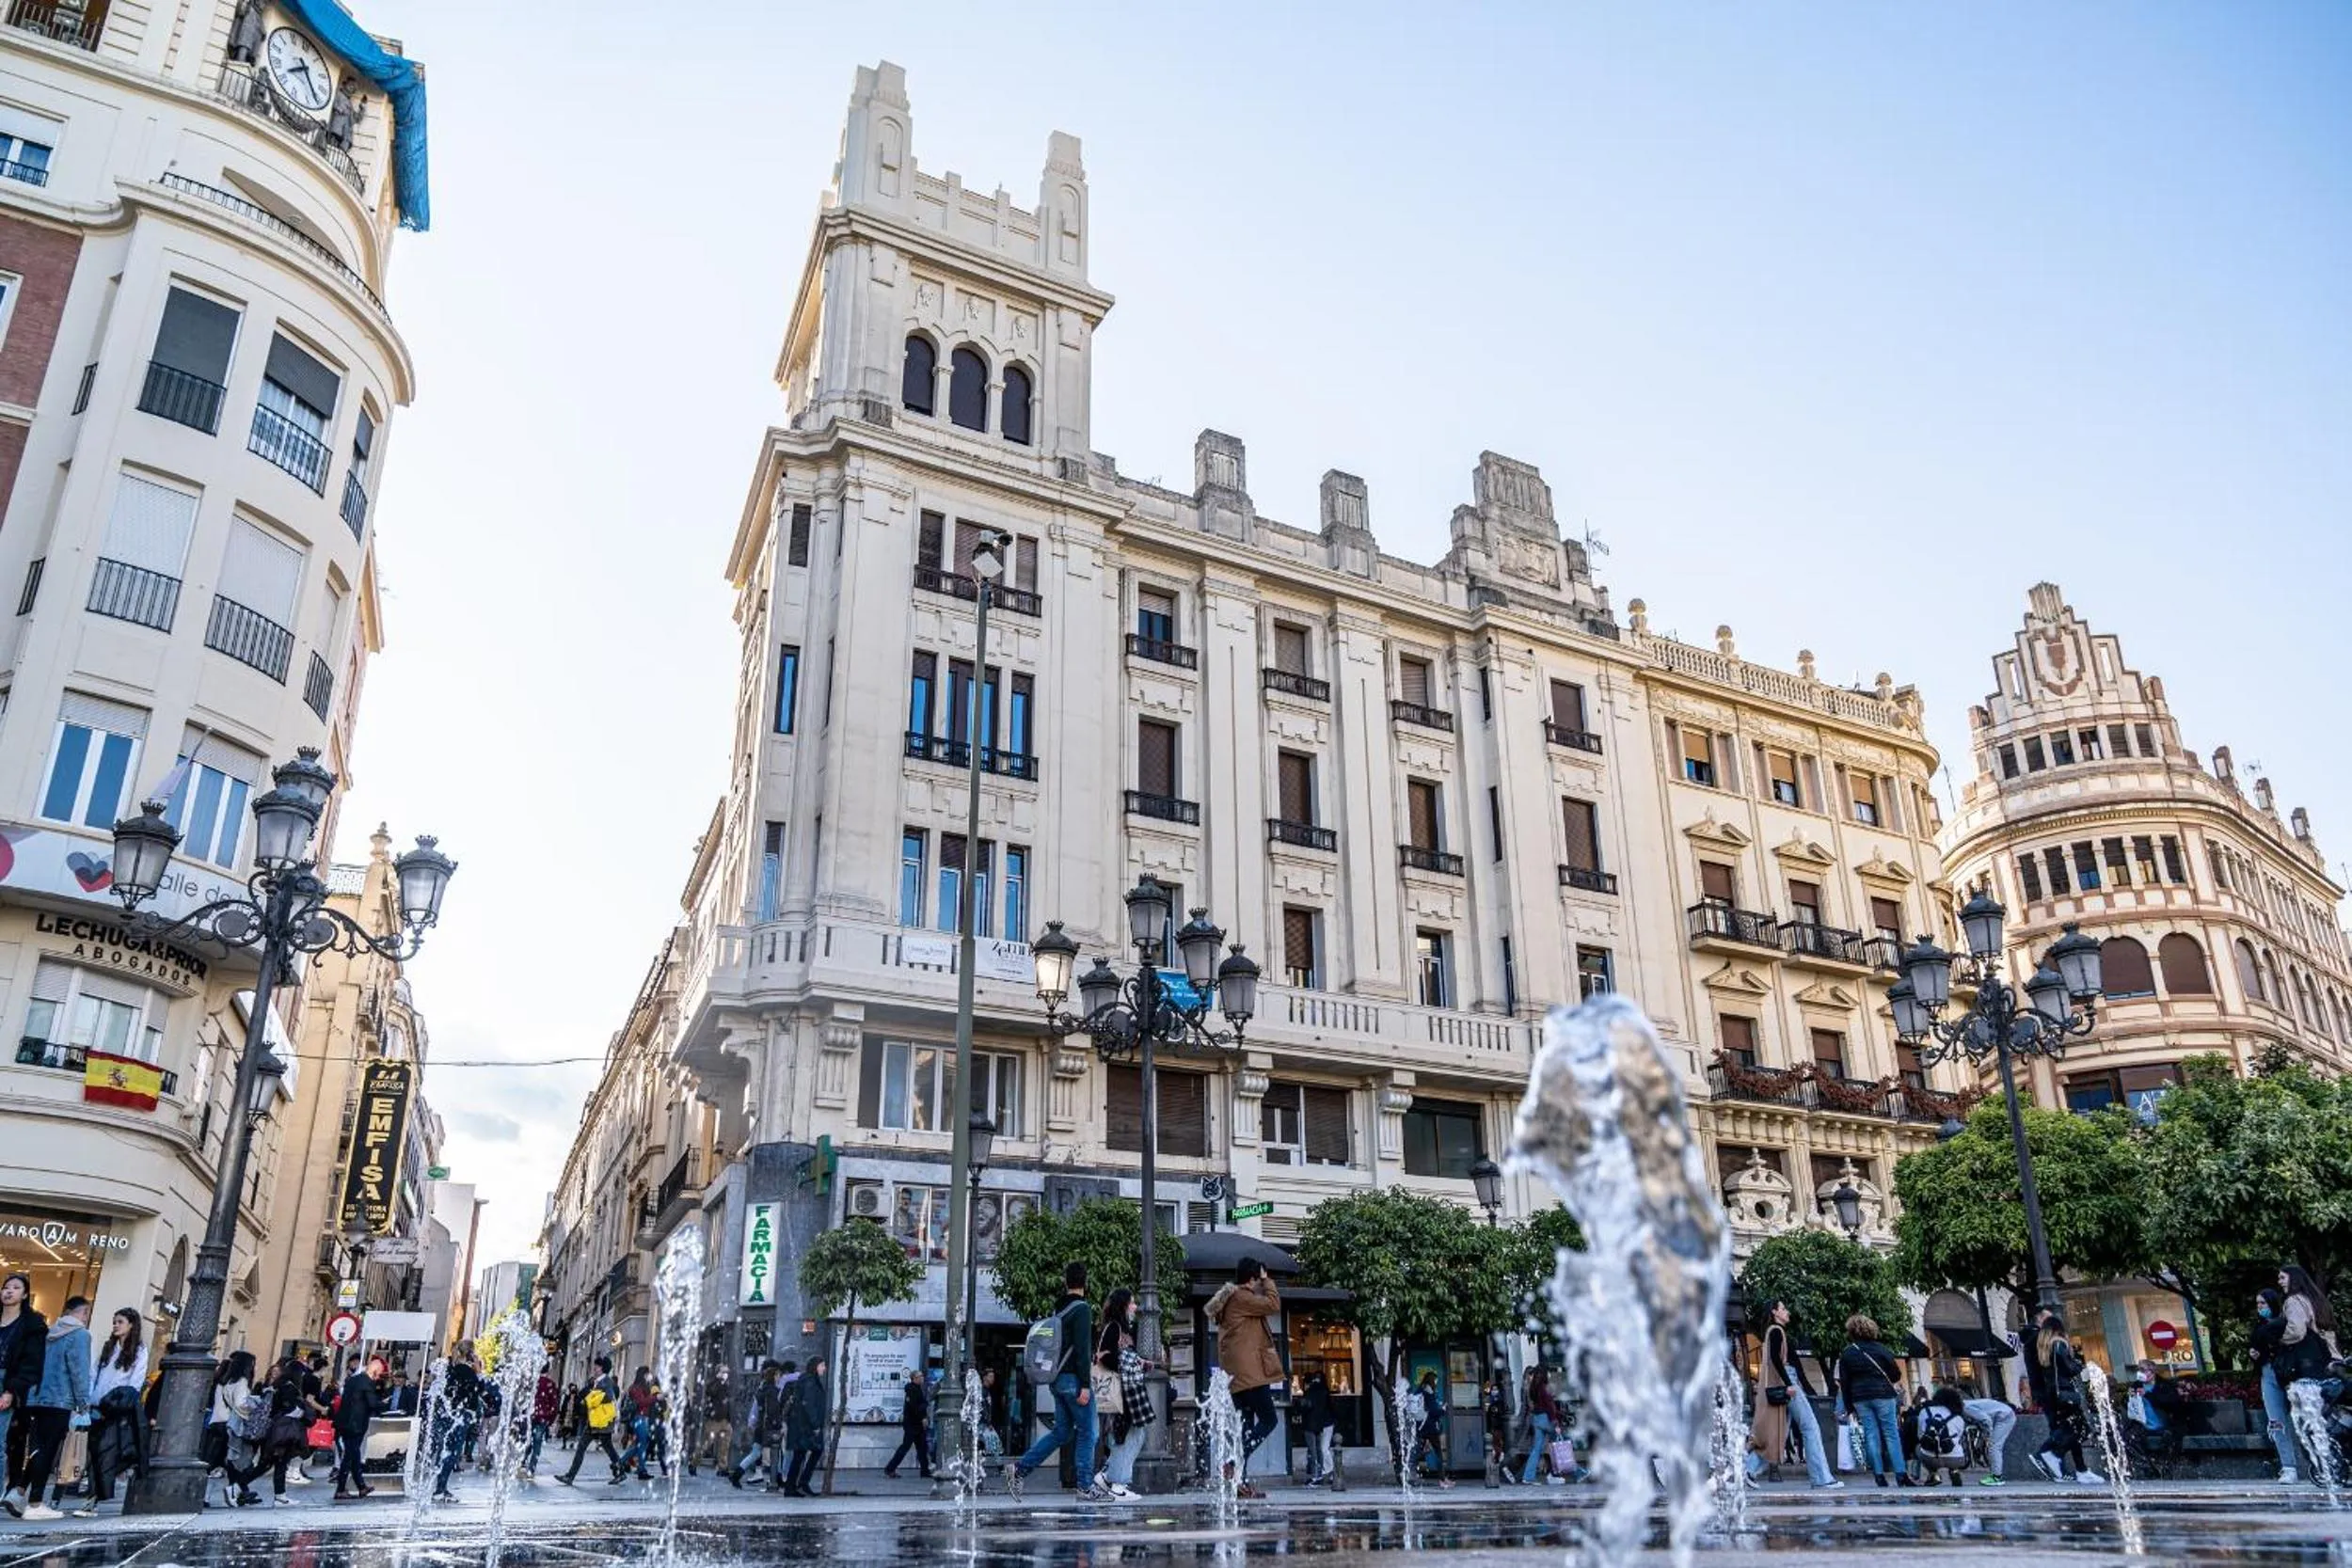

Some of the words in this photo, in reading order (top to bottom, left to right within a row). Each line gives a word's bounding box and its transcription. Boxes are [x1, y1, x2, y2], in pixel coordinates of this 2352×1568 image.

[158, 872, 199, 897] alle
[73, 943, 191, 985] ABOGADOS
[356, 1097, 396, 1200] EMFISA
[748, 1205, 771, 1303] FARMACIA
